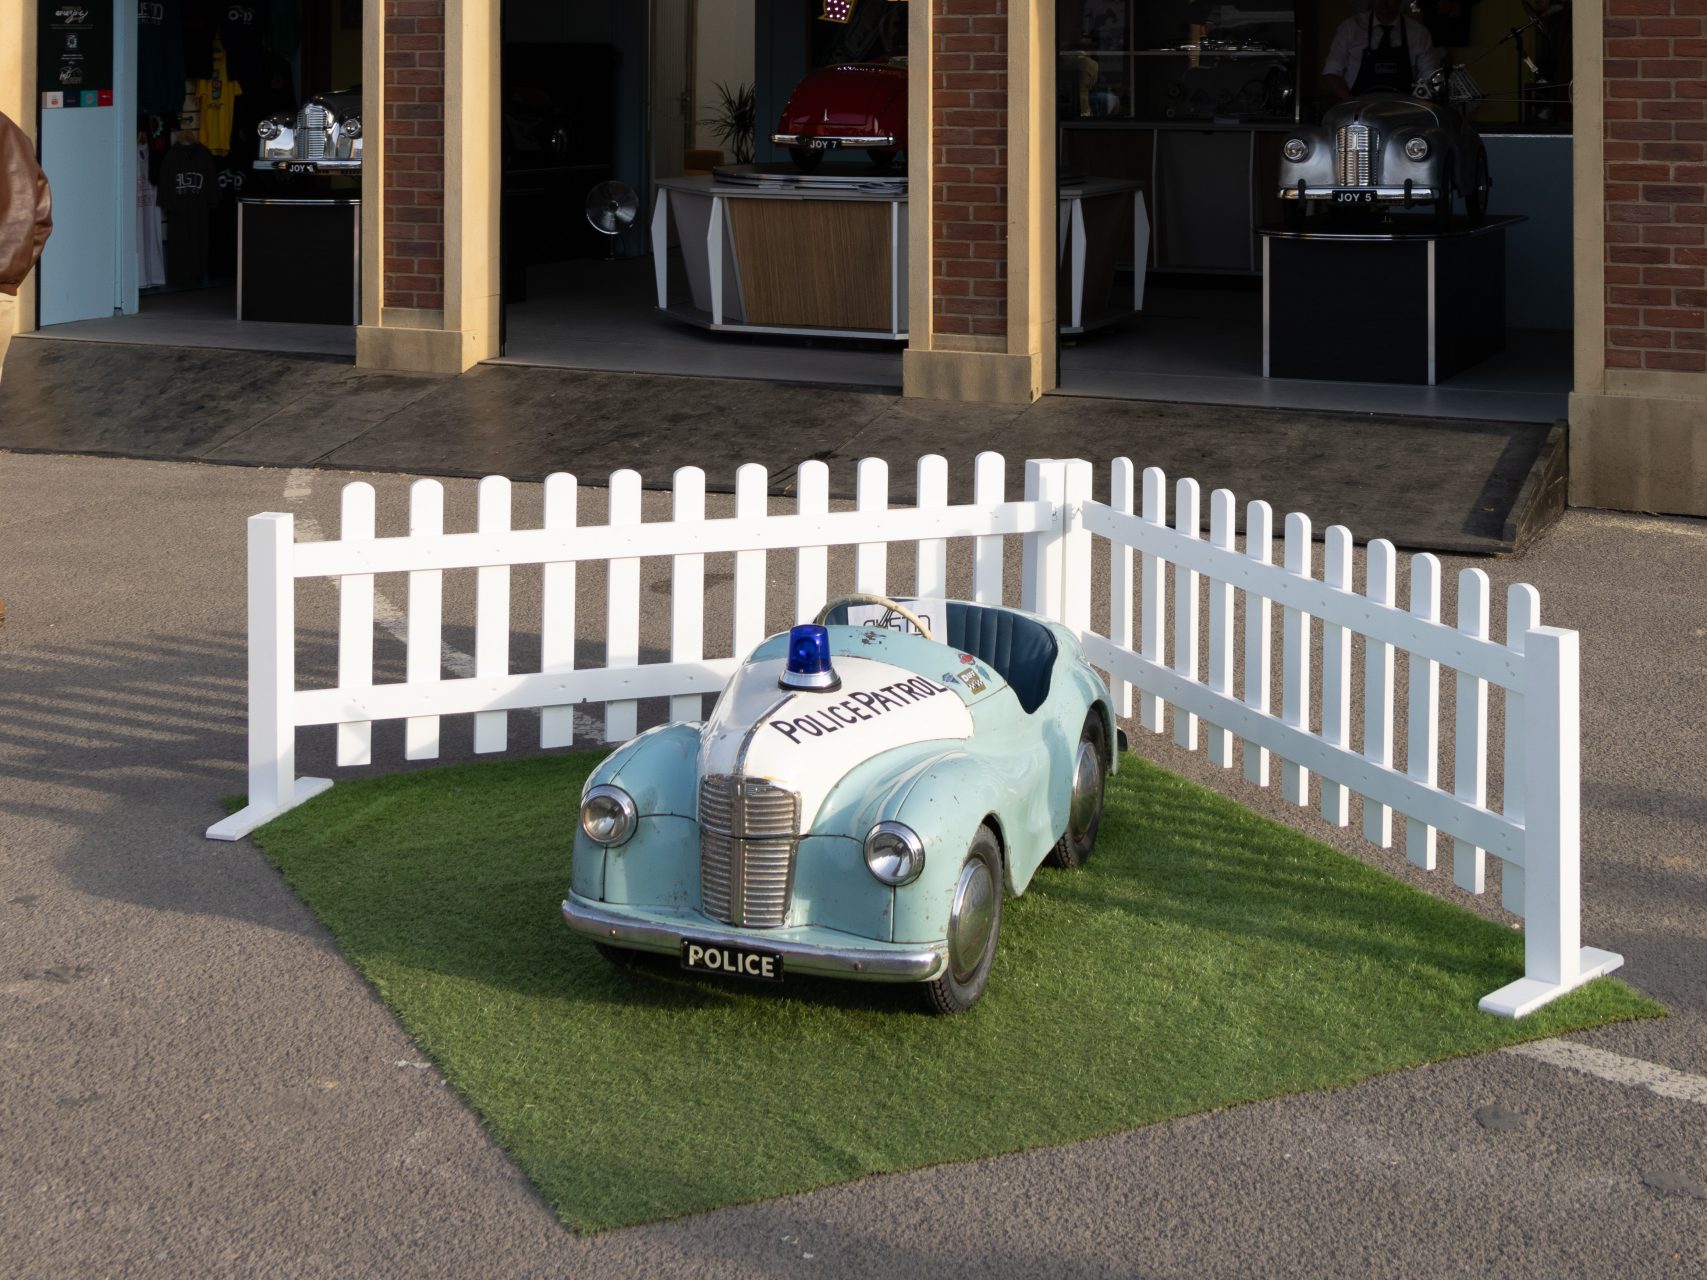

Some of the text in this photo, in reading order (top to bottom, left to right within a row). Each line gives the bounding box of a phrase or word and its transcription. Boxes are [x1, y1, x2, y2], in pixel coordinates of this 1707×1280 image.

[810, 140, 838, 149] JOY 7
[289, 164, 305, 173] JOY
[1338, 193, 1372, 202] JOY 5
[689, 945, 774, 977] POLICE
